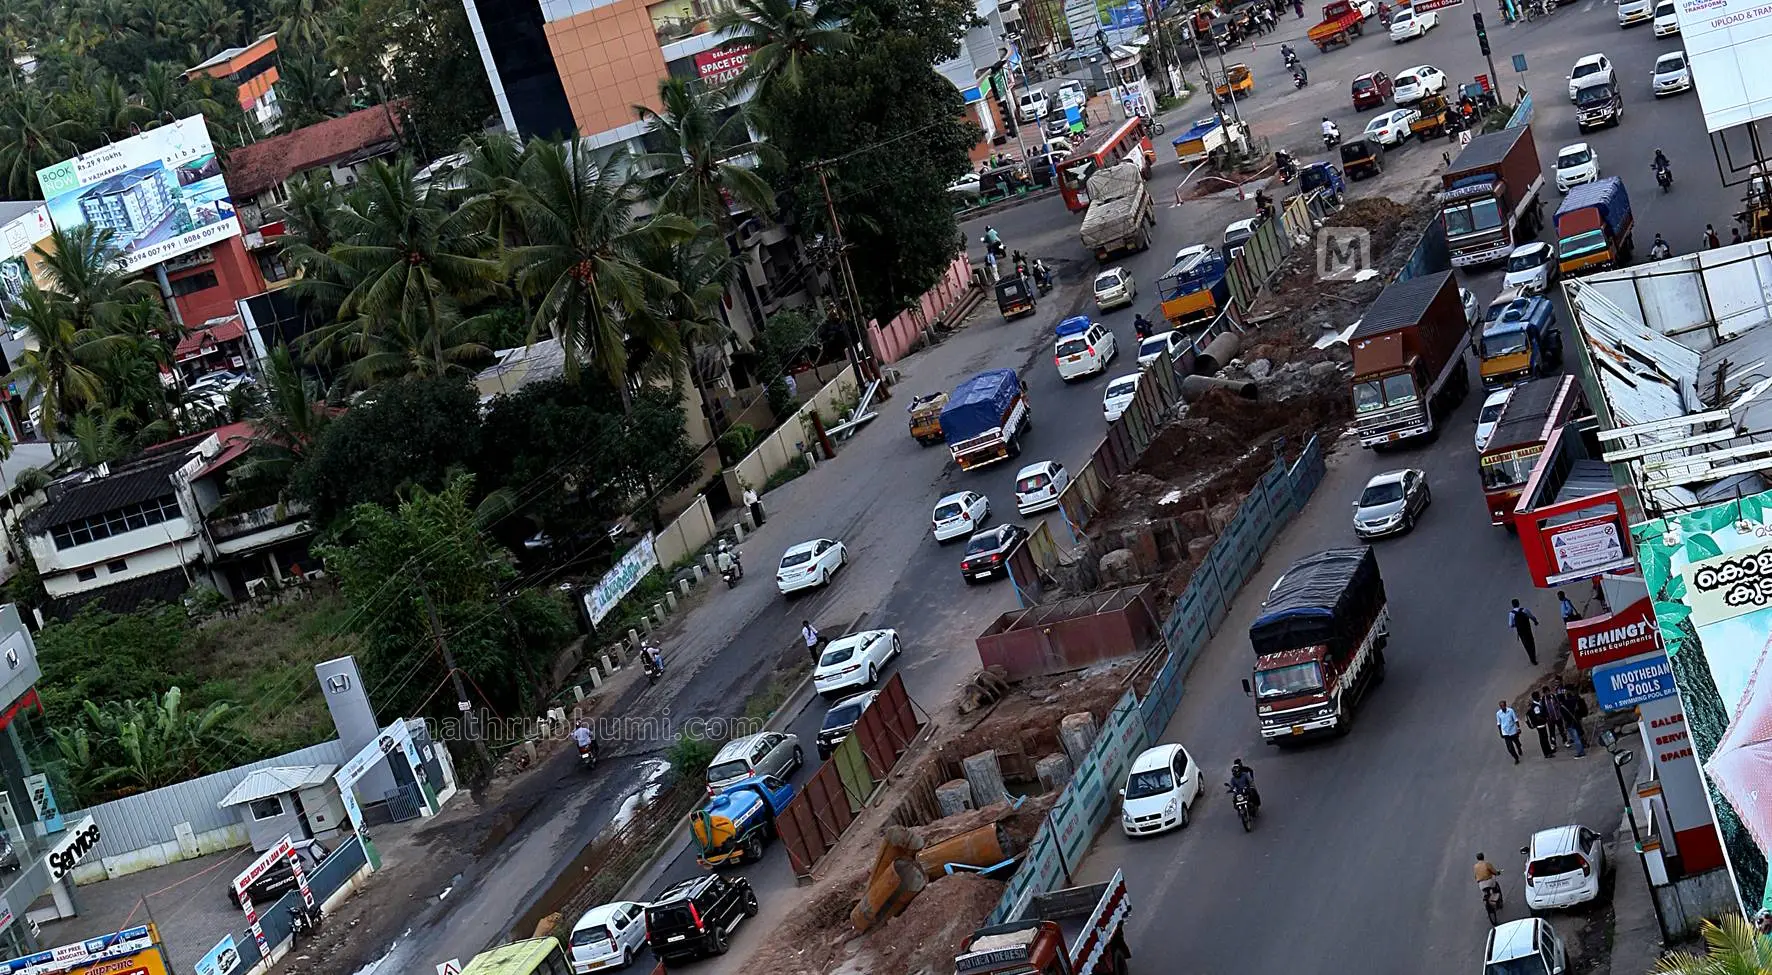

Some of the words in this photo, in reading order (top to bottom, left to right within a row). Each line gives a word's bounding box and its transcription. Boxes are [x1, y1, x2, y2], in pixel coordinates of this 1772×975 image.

[1711, 13, 1745, 28] UPLOAD
[1746, 11, 1753, 19] &
[701, 58, 731, 73] SPACE
[42, 165, 72, 183] BOOK
[46, 176, 74, 195] NOW
[129, 253, 147, 264] 8594
[148, 246, 160, 257] 007
[162, 242, 176, 253] 999
[202, 228, 216, 239] 007
[217, 222, 231, 233] 999
[1580, 645, 1607, 657] Fitness
[1609, 634, 1653, 650] Equipments
[1611, 662, 1671, 691] MOOTHEDAN
[1627, 680, 1661, 698] POOLS
[1619, 695, 1648, 707] SWIMMING
[1648, 691, 1664, 700] POOL
[49, 824, 101, 878] Service
[56, 949, 88, 962] ASSOCIATES
